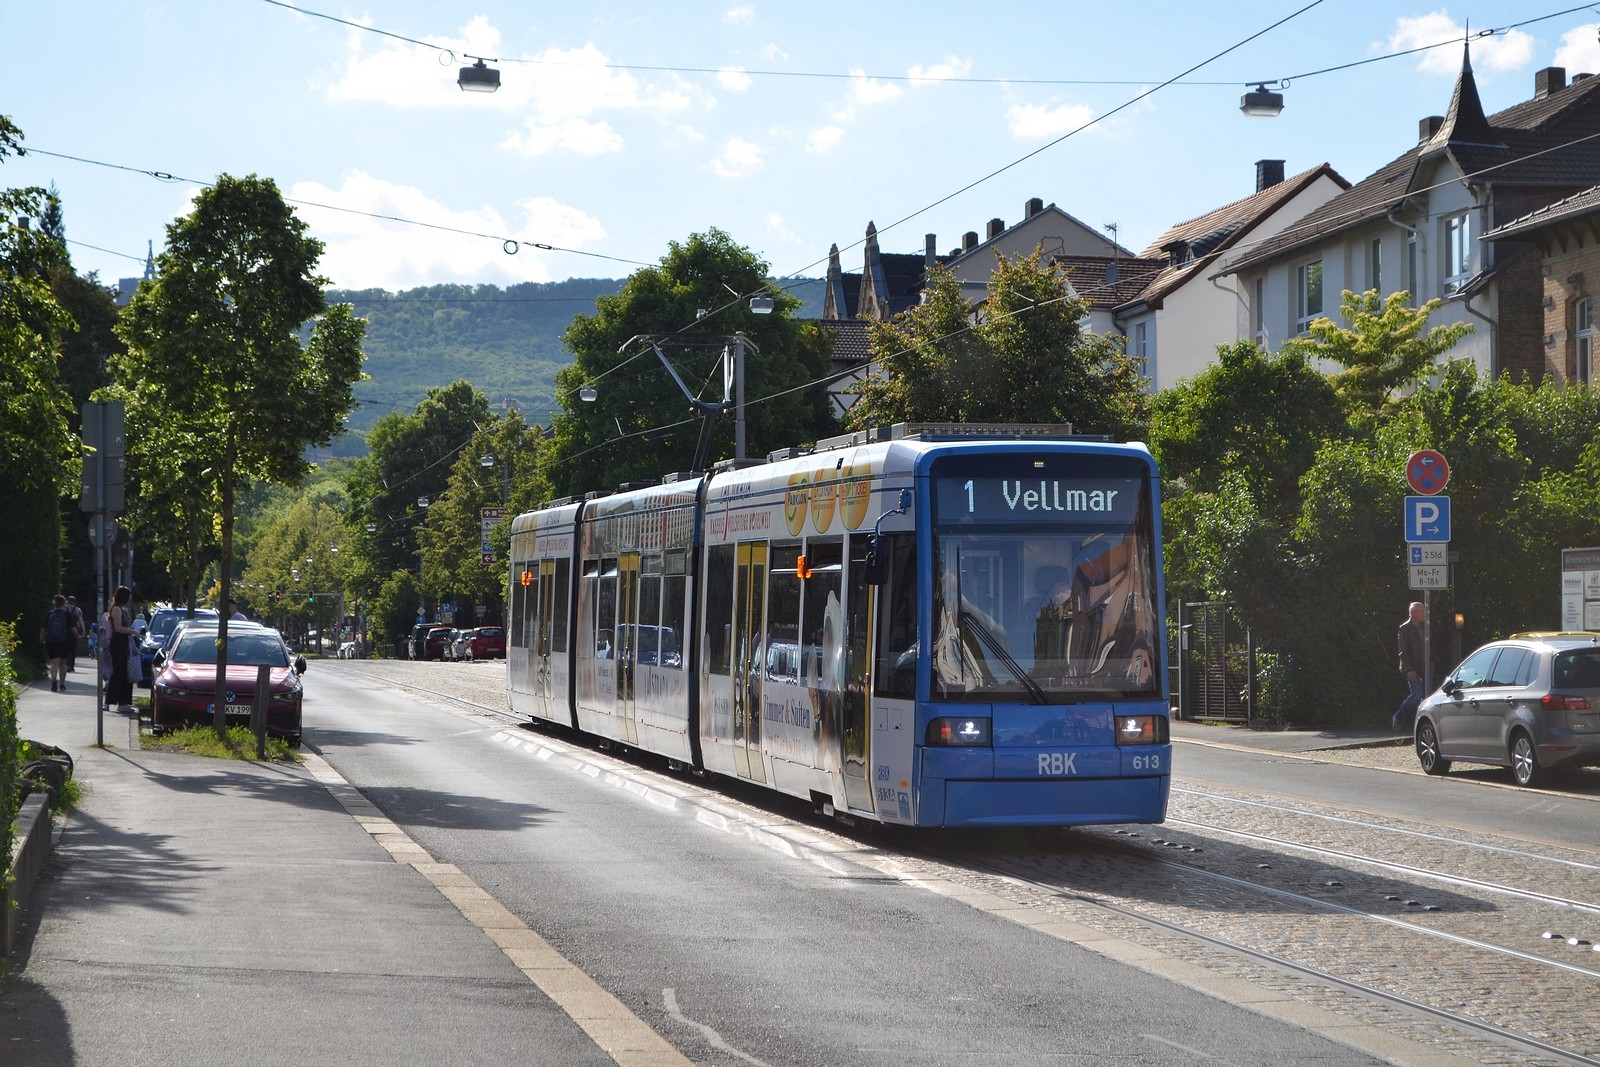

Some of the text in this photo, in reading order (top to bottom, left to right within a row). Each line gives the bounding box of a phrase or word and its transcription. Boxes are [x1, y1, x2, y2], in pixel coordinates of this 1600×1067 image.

[965, 480, 1118, 512] 1 Vellmar
[1416, 502, 1440, 536] P
[1424, 551, 1443, 559] 2 Std.
[1417, 569, 1440, 577] Mo-Fr
[225, 705, 236, 714] KV
[237, 706, 251, 714] 199
[763, 694, 810, 729] Zimmer & Suiten
[1038, 753, 1077, 775] RBK
[1133, 755, 1160, 770] 613
[878, 765, 890, 781] RBK
